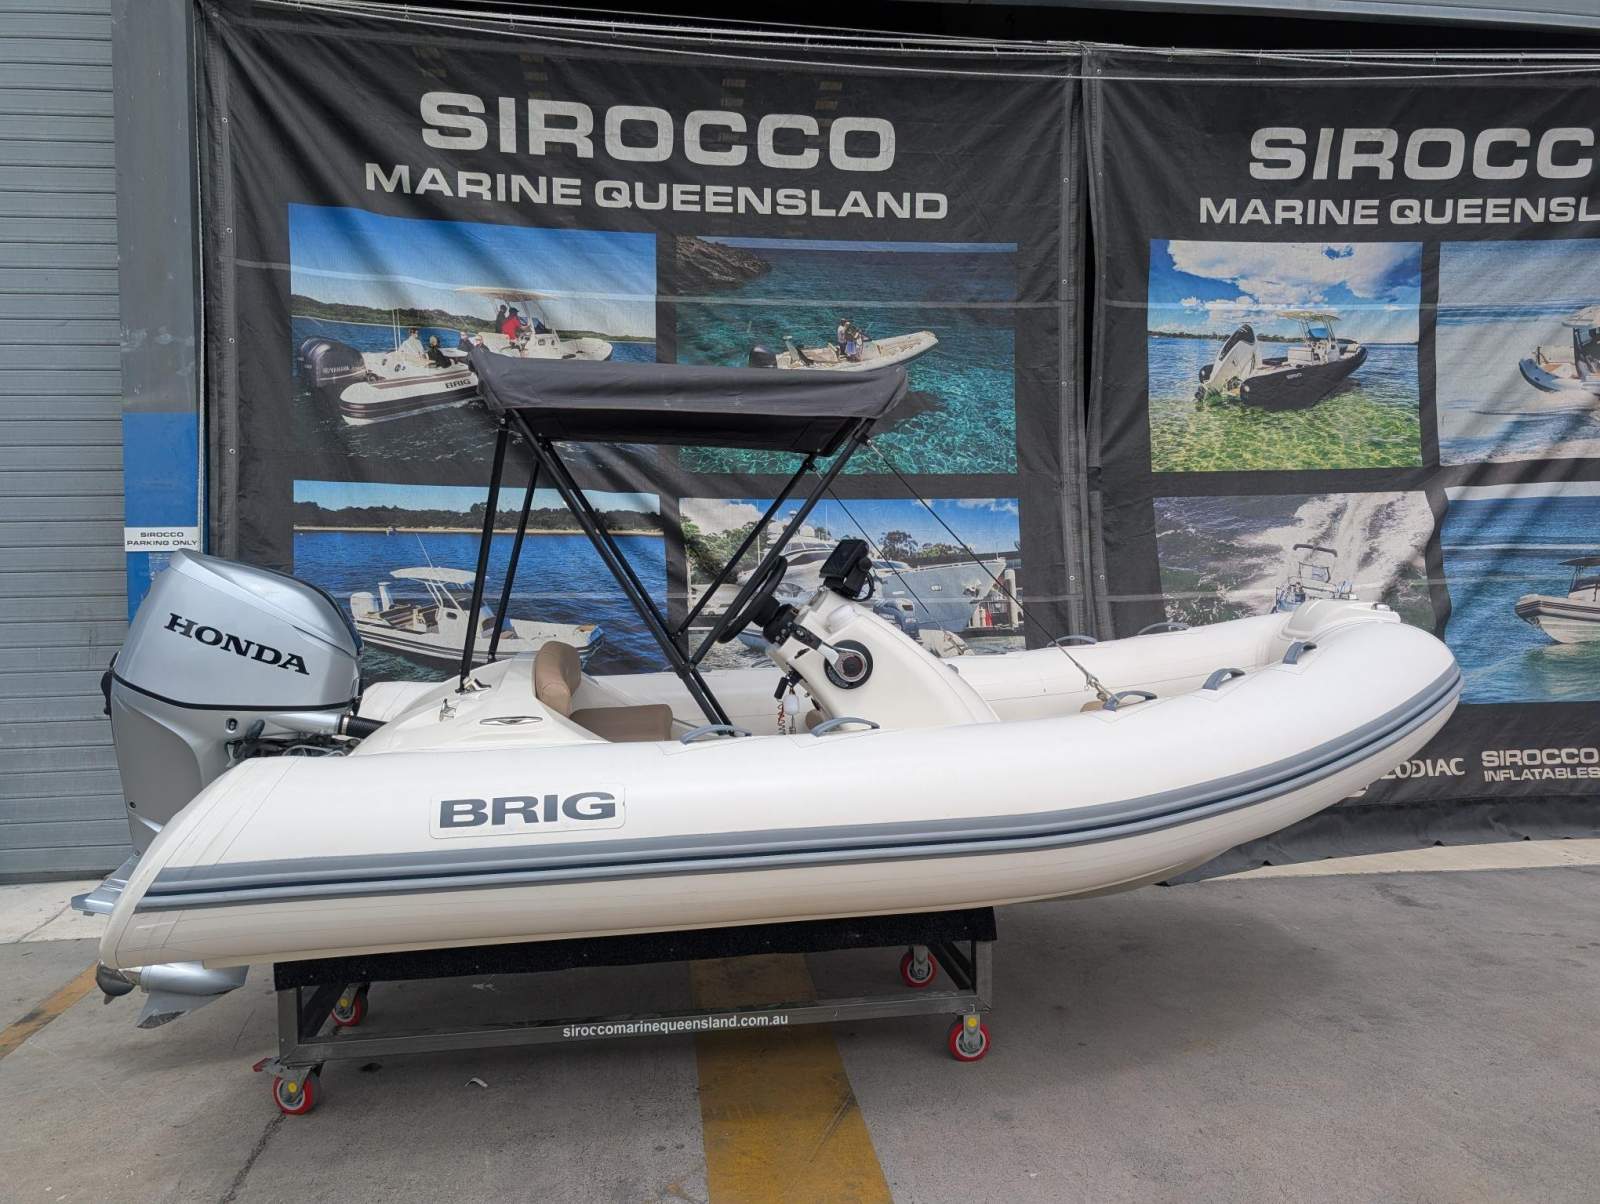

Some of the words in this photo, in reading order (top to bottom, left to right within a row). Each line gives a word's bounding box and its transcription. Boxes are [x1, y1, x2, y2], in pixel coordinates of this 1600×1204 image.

[420, 91, 896, 172] SIROCCO
[1249, 127, 1595, 181] SIROCC
[365, 162, 582, 206] MARINE
[594, 180, 948, 219] QUEENSLAND
[1199, 197, 1380, 225] MARINE
[1390, 196, 1600, 225] QUEENSL
[163, 613, 310, 676] HONDA
[1481, 747, 1600, 767] SIROCCO
[1483, 766, 1600, 782] INFLATABLES
[440, 791, 616, 829] BRIG
[562, 1015, 788, 1038] siroccomarinequeensland.com.au
